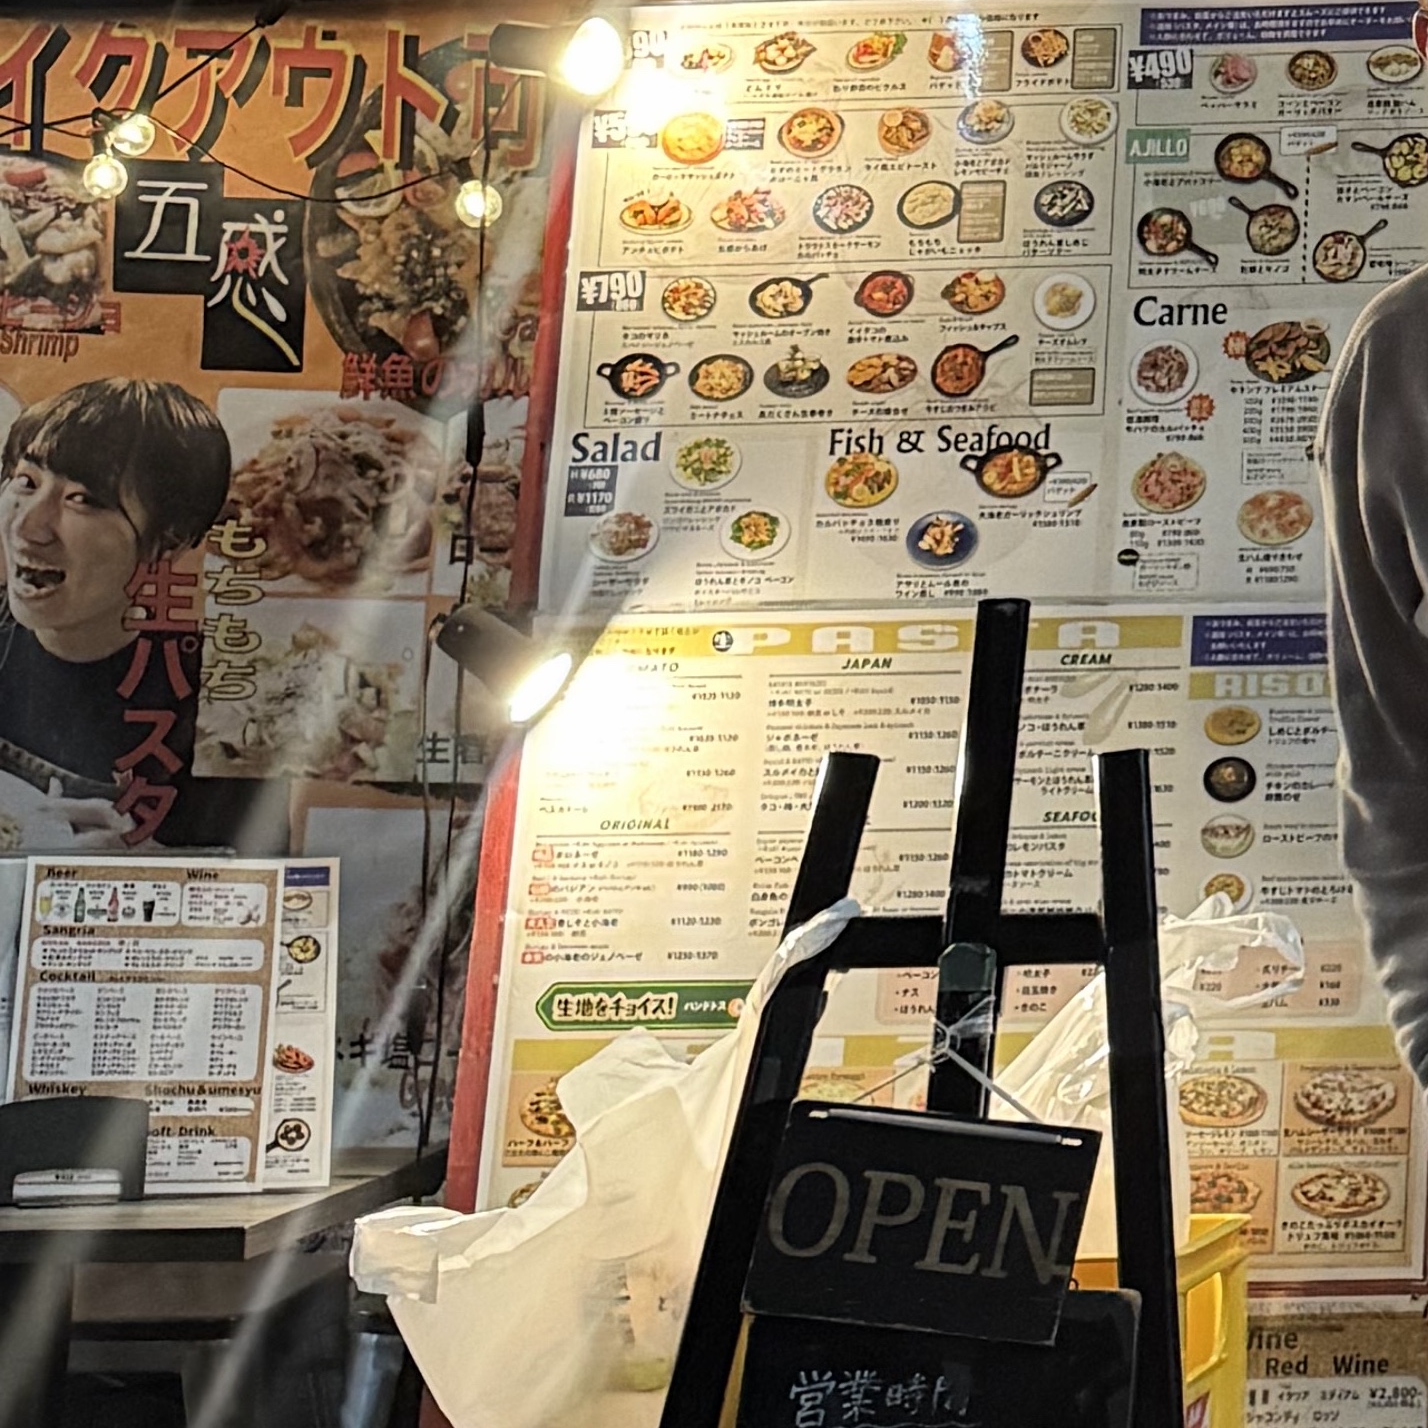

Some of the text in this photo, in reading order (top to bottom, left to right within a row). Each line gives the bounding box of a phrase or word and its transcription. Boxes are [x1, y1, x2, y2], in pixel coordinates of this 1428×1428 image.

[1128, 47, 1192, 83] ¥490
[1129, 137, 1188, 157] AJILLO
[580, 271, 644, 305] ¥790
[1133, 296, 1228, 328] Carne
[570, 430, 663, 464] Salad
[828, 422, 1052, 457] Fish & Seafood
[202, 517, 269, 702] もちもち
[841, 657, 893, 671] JAPAN
[1060, 653, 1112, 666] CREAM
[112, 557, 199, 848] 生パスタ
[599, 817, 671, 831] ORIGINAL
[186, 868, 219, 881] Wine
[43, 924, 95, 939] Sangria
[39, 970, 97, 984] Cocktail
[555, 996, 675, 1019] 生地をチョイス!
[28, 1083, 87, 1097] Whiskey
[179, 1125, 216, 1138] Drink
[767, 1161, 1081, 1286] OPEN
[1265, 1353, 1390, 1377] Red Wine
